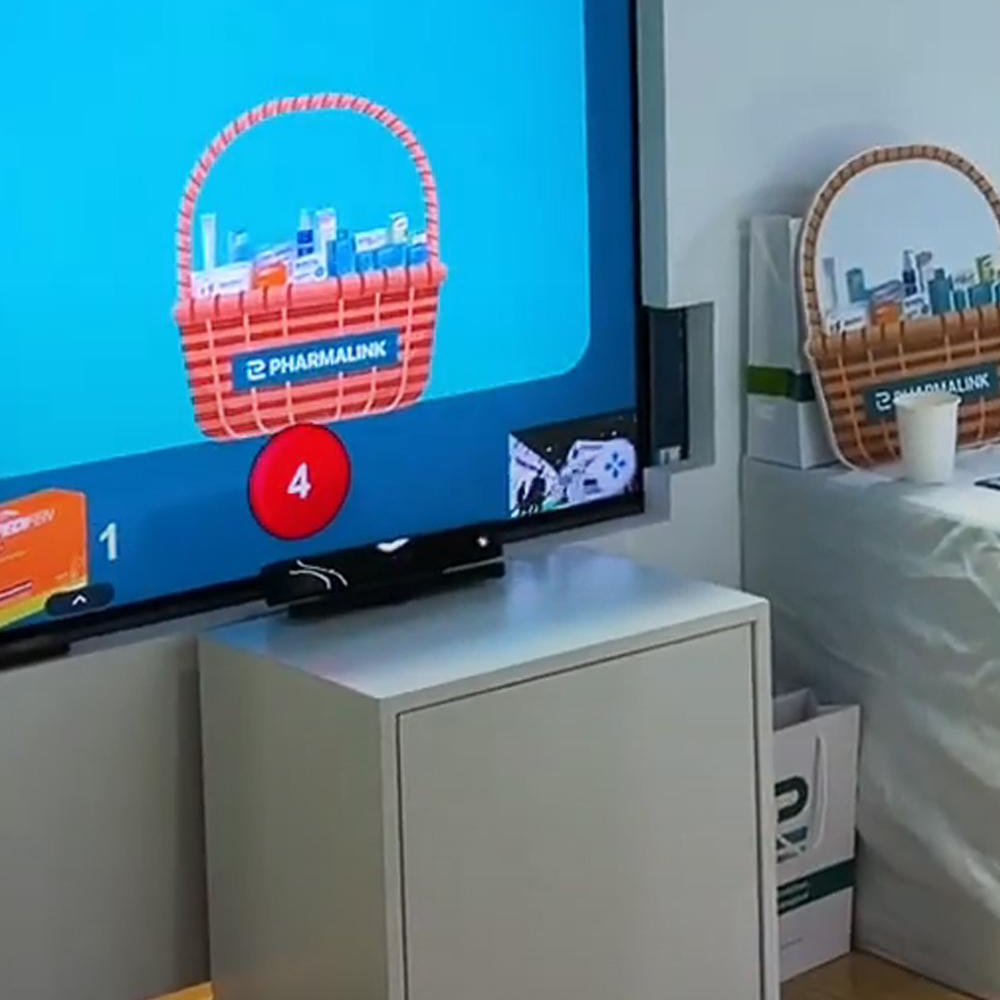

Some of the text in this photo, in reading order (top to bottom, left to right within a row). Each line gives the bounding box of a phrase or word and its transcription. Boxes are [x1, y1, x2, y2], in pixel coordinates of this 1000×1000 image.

[269, 339, 387, 376] PHARMALINK
[287, 462, 311, 499] 4
[99, 522, 118, 561] 1
